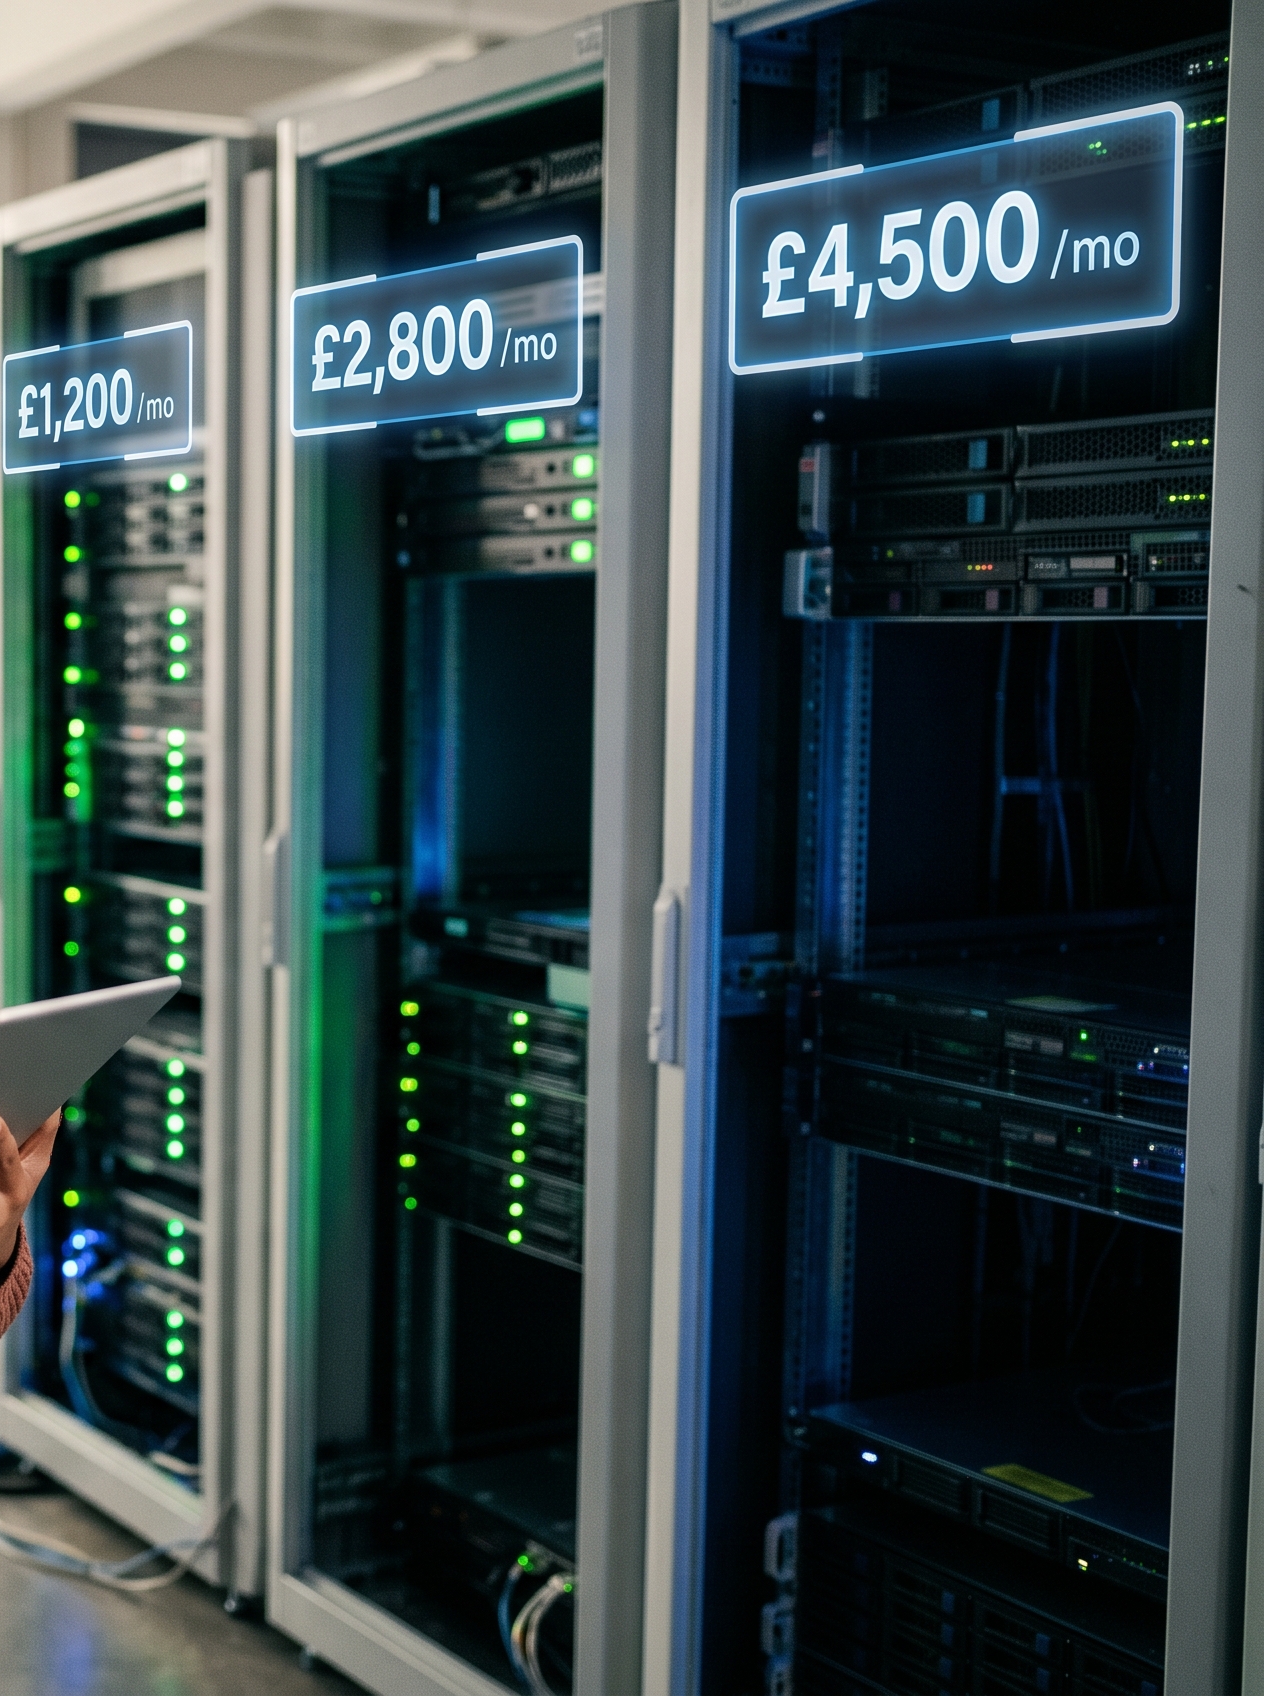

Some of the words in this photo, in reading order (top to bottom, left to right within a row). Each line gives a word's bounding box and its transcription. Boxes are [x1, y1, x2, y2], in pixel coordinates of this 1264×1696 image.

[762, 190, 1040, 320] £4,500
[1050, 229, 1140, 280] /mo
[311, 298, 494, 395] £2,800
[500, 327, 557, 368] /mo
[18, 368, 133, 443] £1,200
[137, 392, 174, 423] /mo
